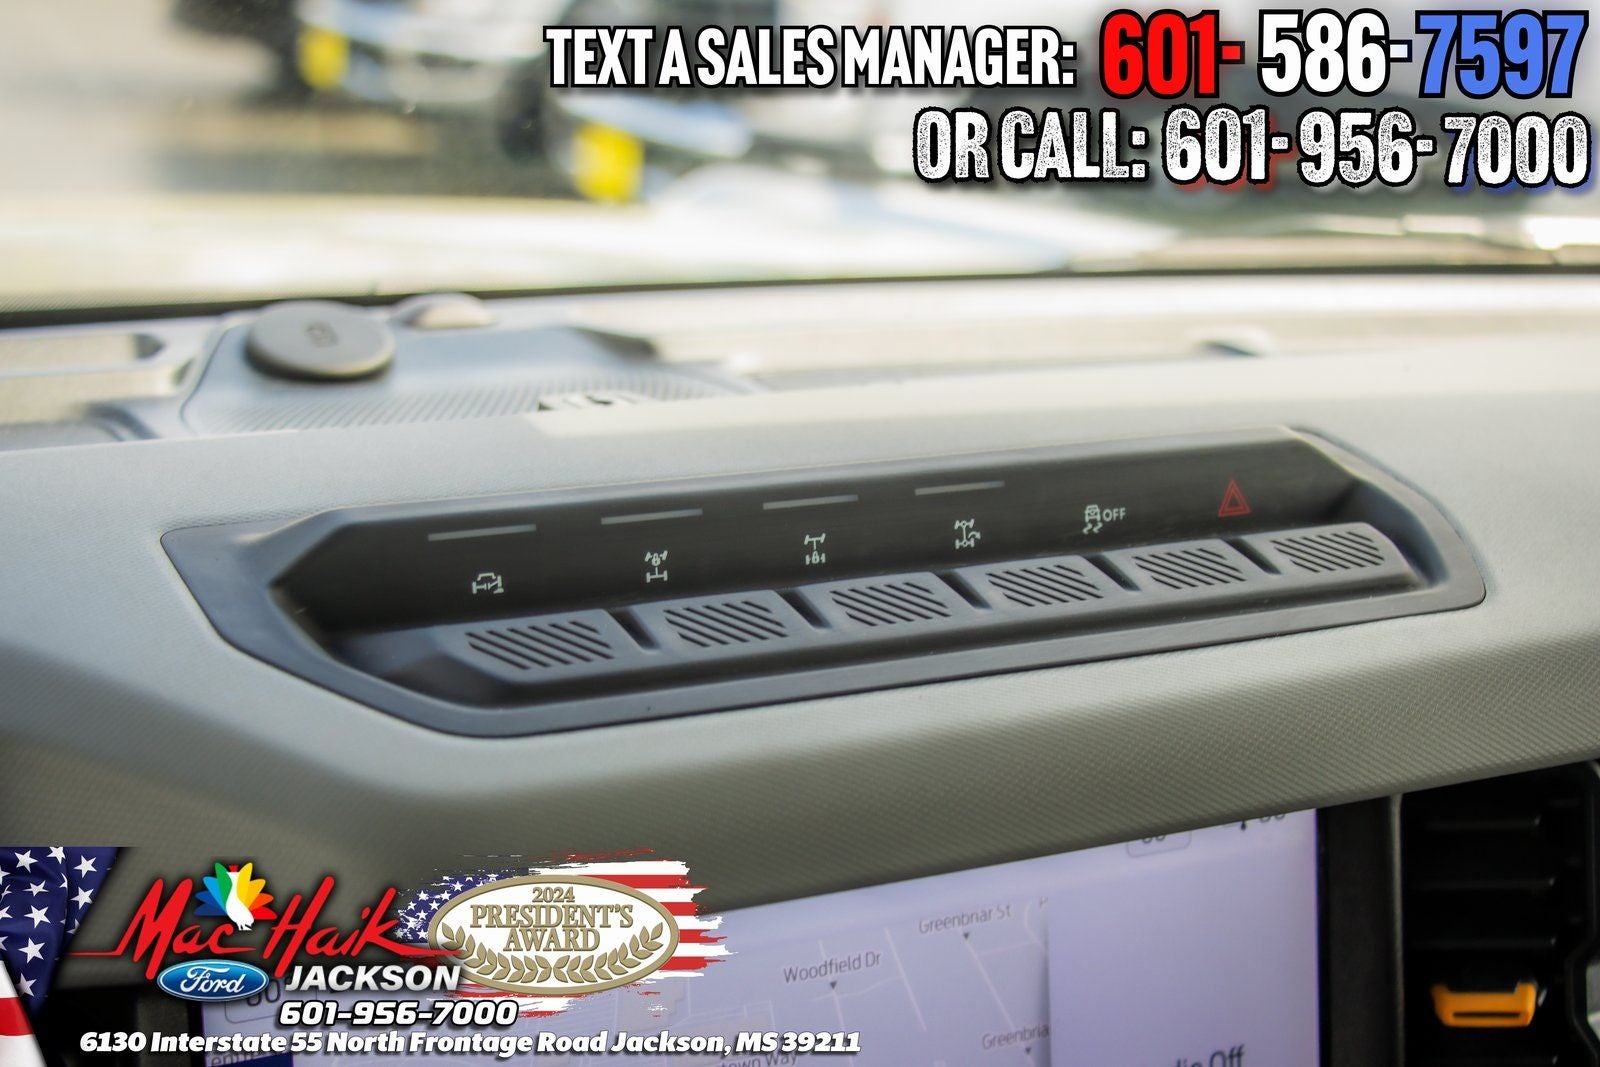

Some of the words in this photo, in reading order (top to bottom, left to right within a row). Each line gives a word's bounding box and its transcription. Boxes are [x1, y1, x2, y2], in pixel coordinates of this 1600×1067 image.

[1102, 507, 1126, 522] OFF
[919, 908, 993, 934] Greenbriar
[783, 953, 862, 984] Woodfield
[865, 951, 881, 968] Dr
